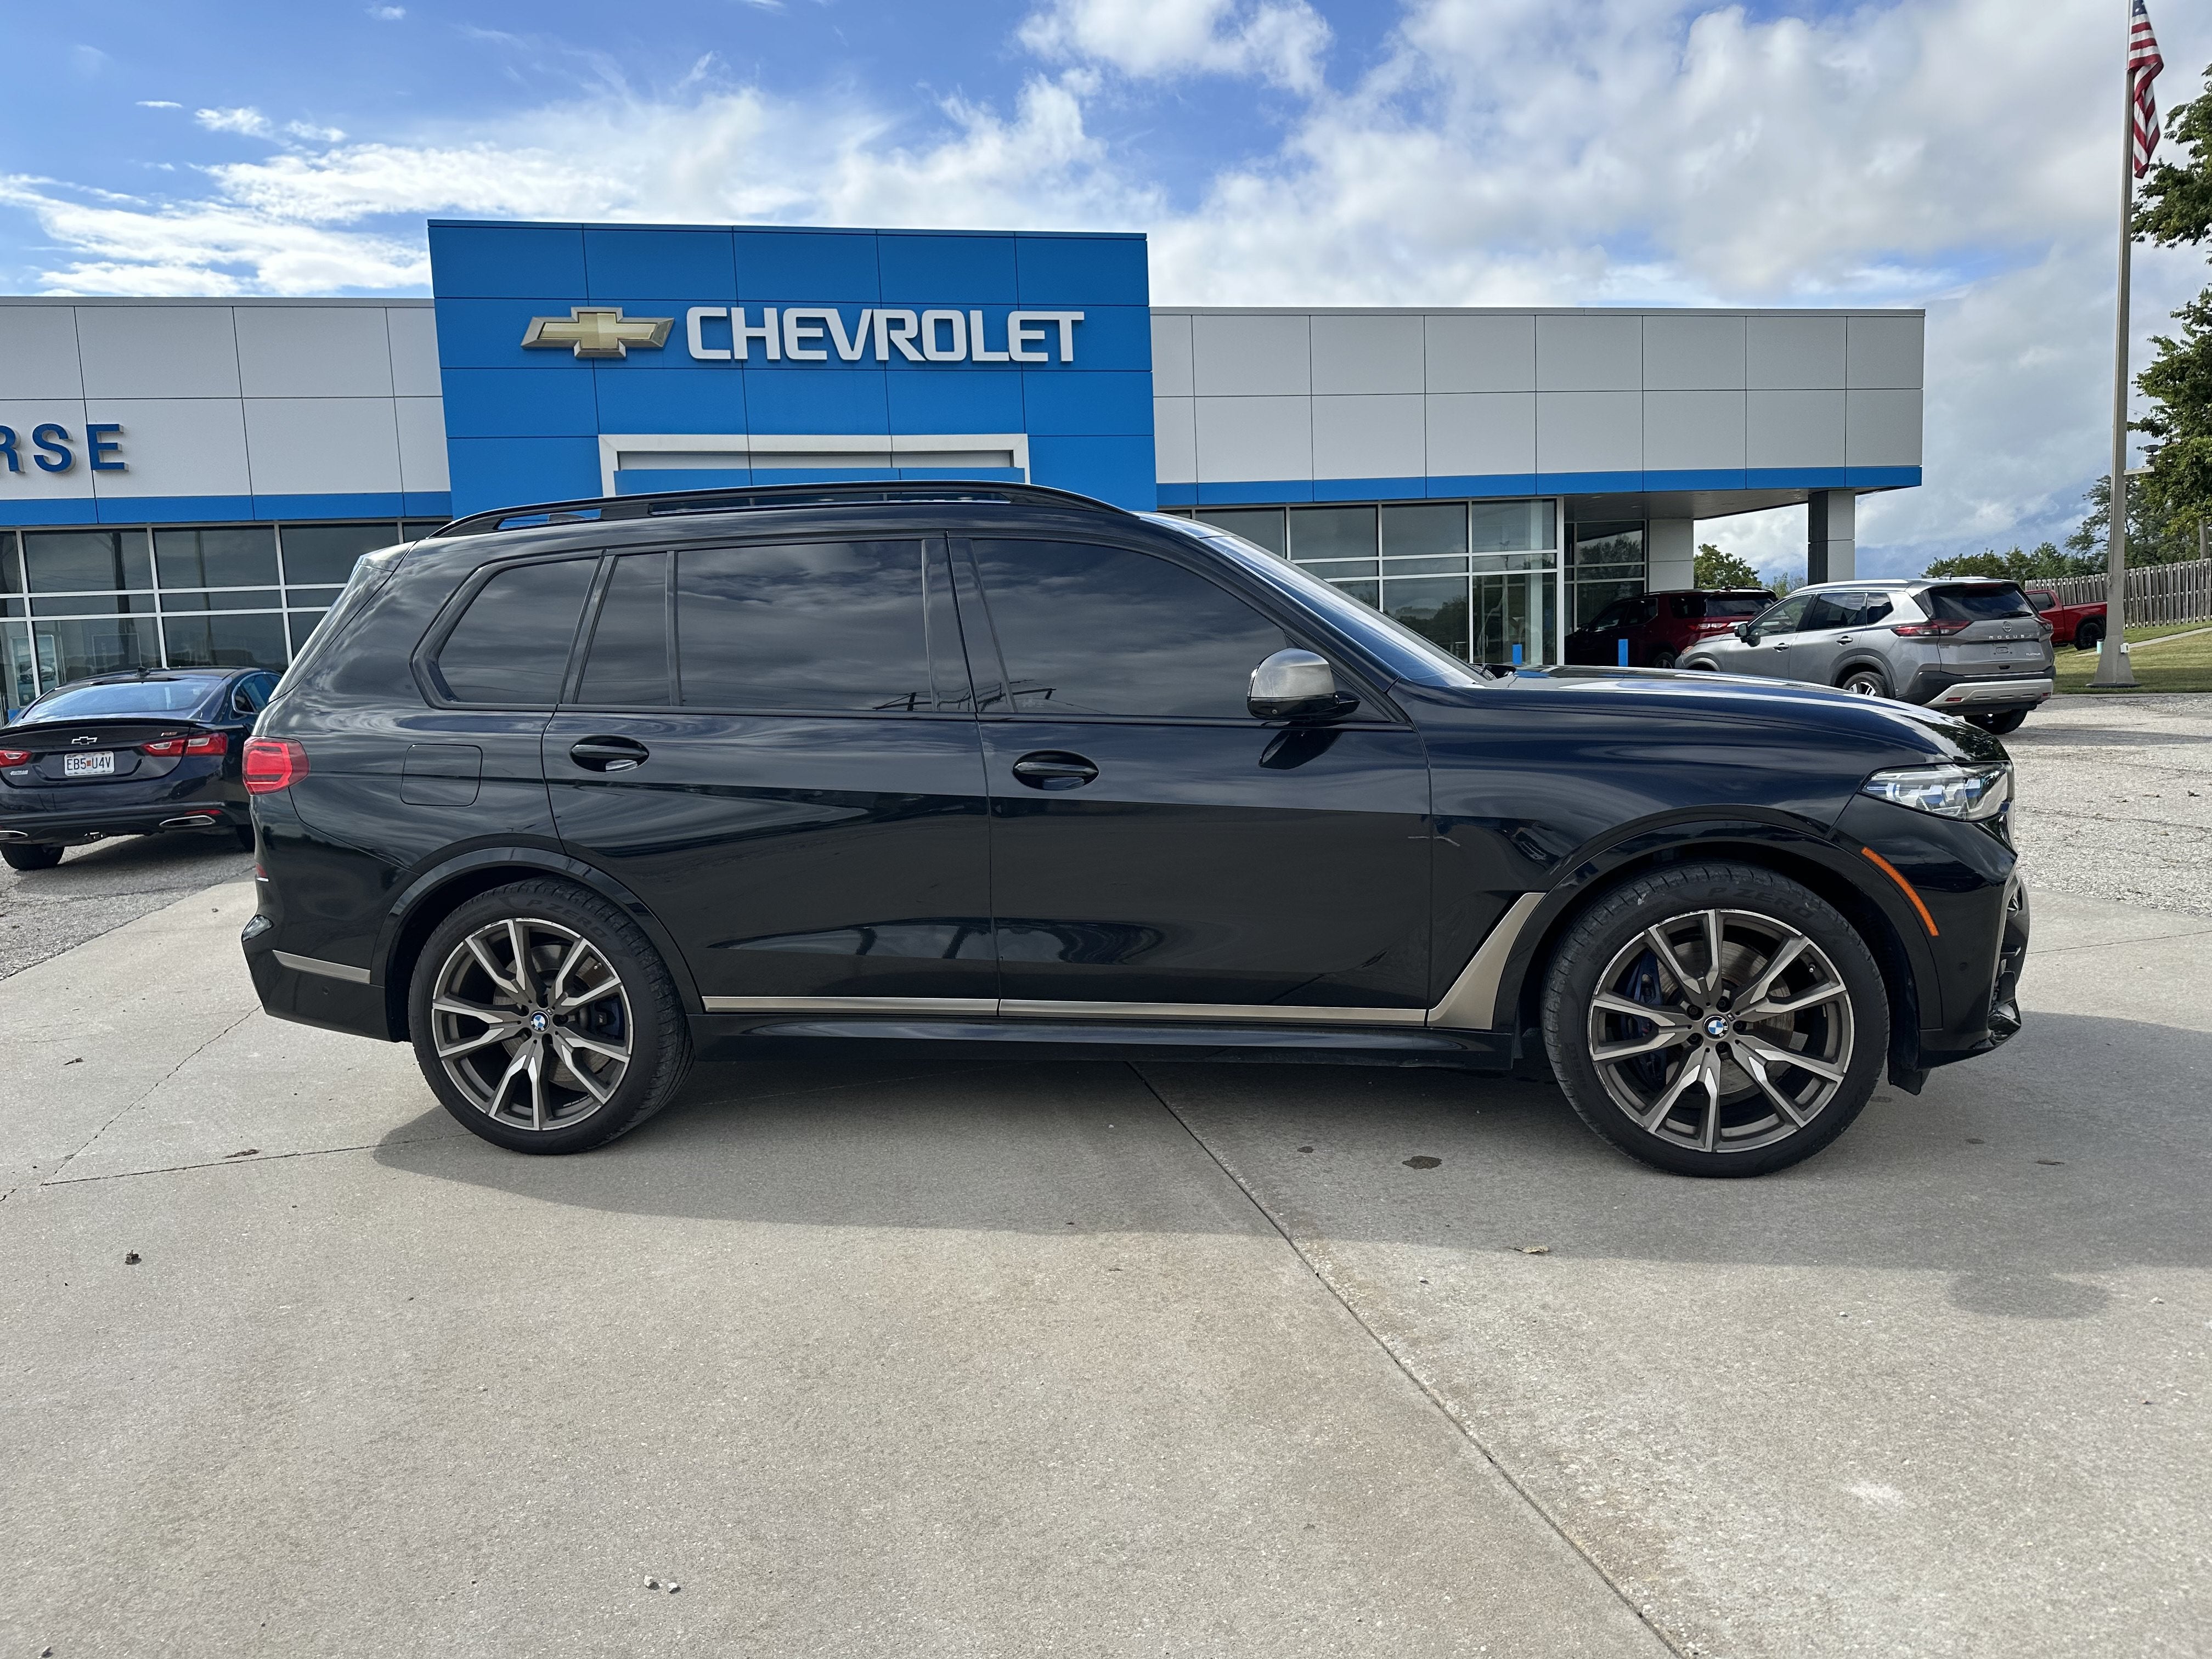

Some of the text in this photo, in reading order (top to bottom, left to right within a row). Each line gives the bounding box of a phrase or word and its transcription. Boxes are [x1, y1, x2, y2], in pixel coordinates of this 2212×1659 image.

[686, 307, 1085, 362] CHEVROLET
[67, 757, 111, 771] EB5 U4V
[1707, 888, 1814, 918] P ZERO
